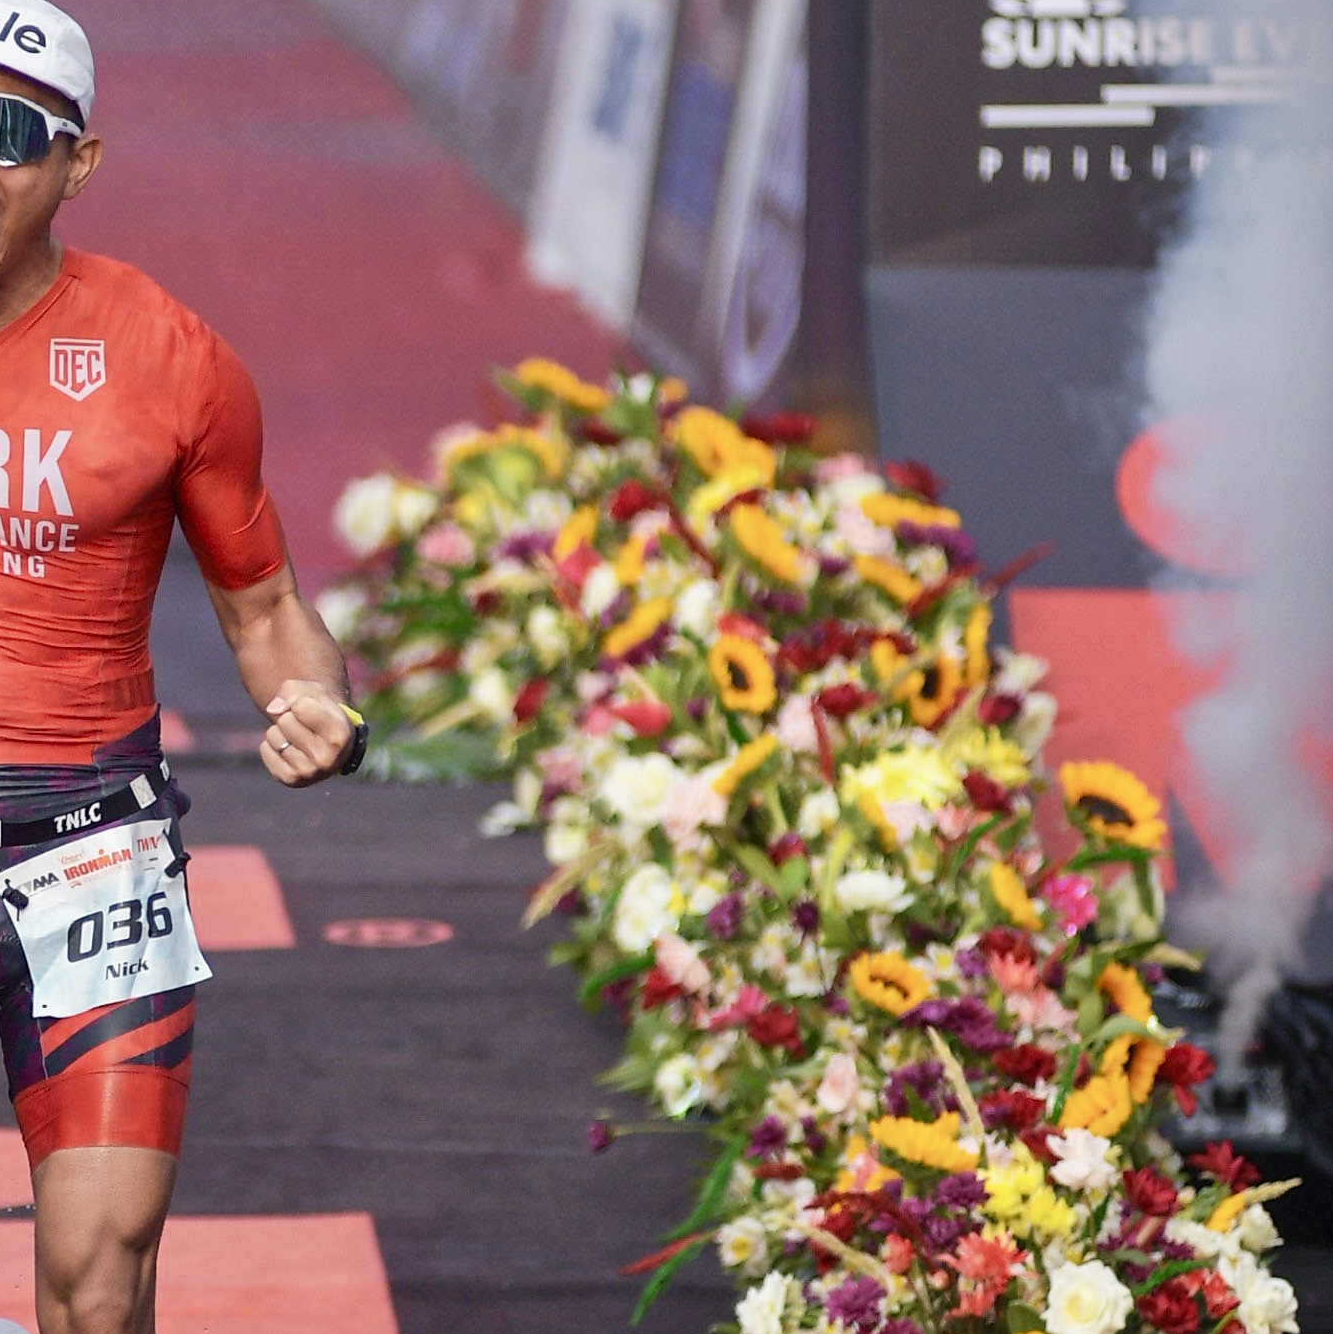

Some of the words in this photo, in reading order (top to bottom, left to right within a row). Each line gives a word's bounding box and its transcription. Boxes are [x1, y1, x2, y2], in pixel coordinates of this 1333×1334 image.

[981, 17, 1215, 69] SUNRISE
[54, 349, 102, 394] DEC
[54, 802, 102, 833] TNLC
[63, 848, 133, 881] IRONMAN
[67, 891, 173, 963] 036
[105, 958, 149, 980] Nick
